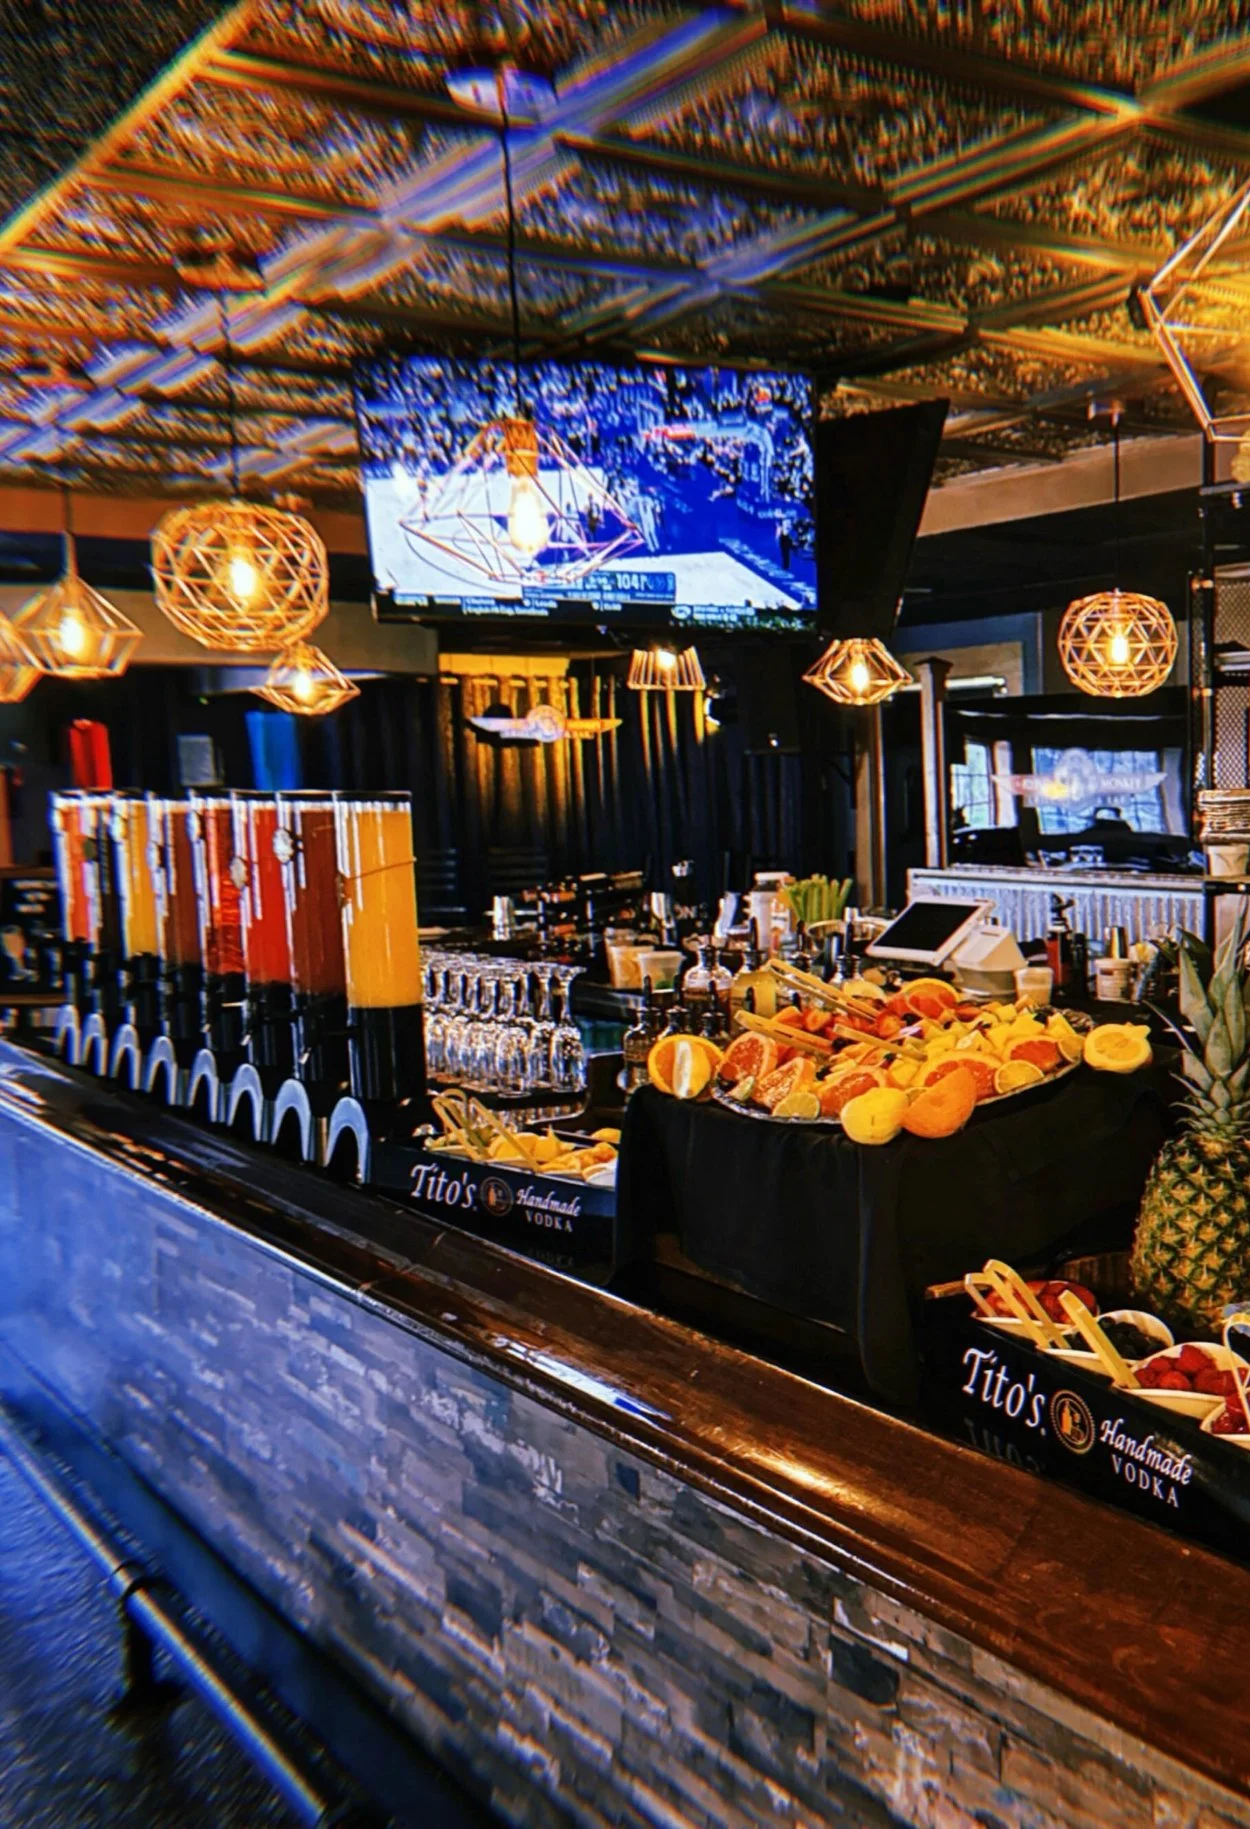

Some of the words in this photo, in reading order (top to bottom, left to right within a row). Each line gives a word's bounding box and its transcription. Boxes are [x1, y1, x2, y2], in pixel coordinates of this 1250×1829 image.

[410, 1163, 477, 1208] Tito's
[516, 1185, 581, 1217] Handmade
[525, 1209, 573, 1232] VODKA
[962, 1348, 1046, 1428] Tito's
[1100, 1419, 1194, 1486] Handmade
[1111, 1454, 1179, 1508] VODKA
